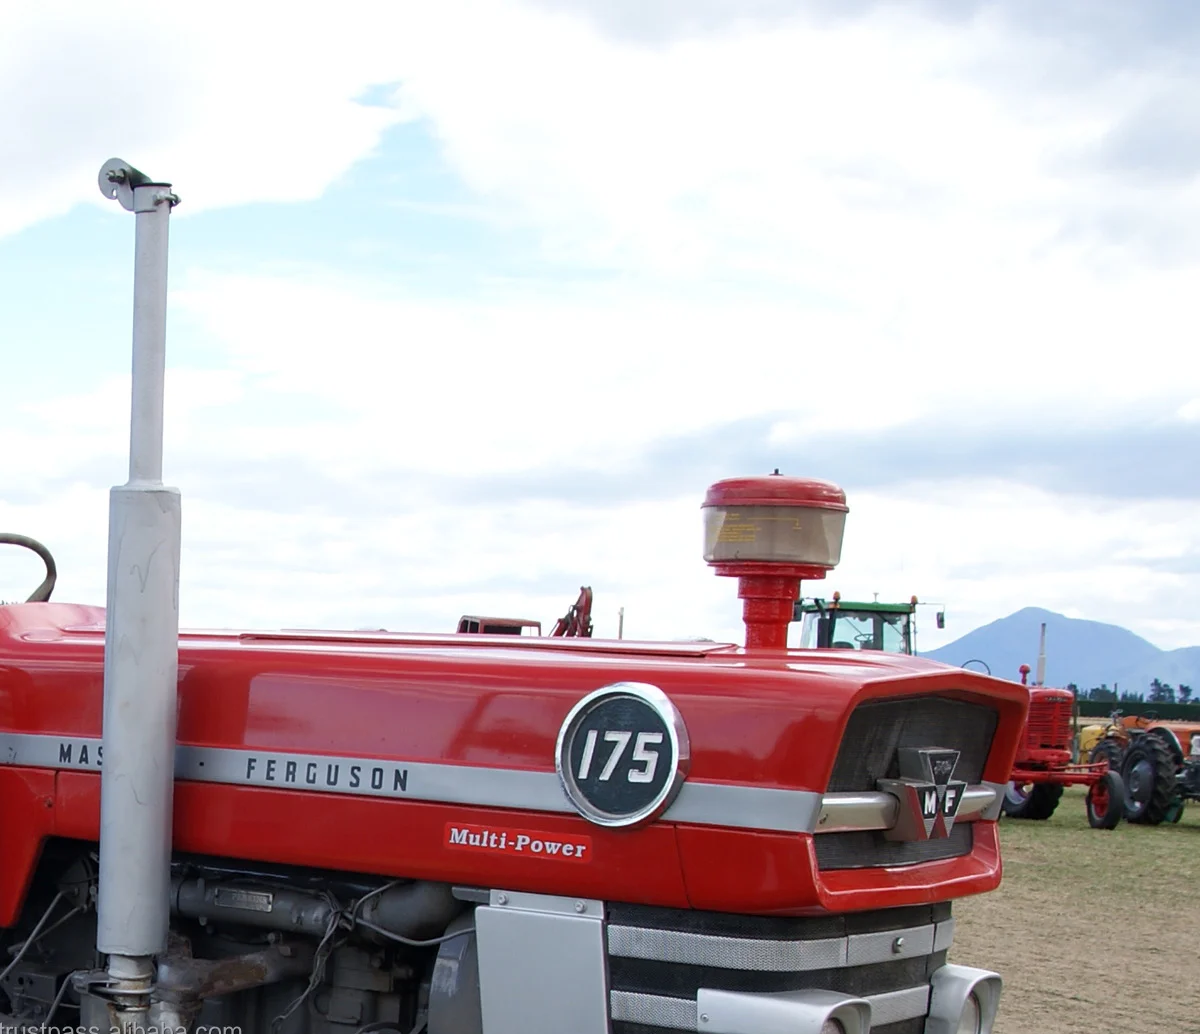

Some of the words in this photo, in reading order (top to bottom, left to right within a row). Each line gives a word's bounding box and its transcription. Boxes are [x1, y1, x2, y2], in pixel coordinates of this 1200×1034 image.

[58, 743, 104, 766] MAS
[246, 757, 408, 792] FERGUSON
[577, 729, 664, 783] 175
[449, 828, 587, 858] Multi-Power
